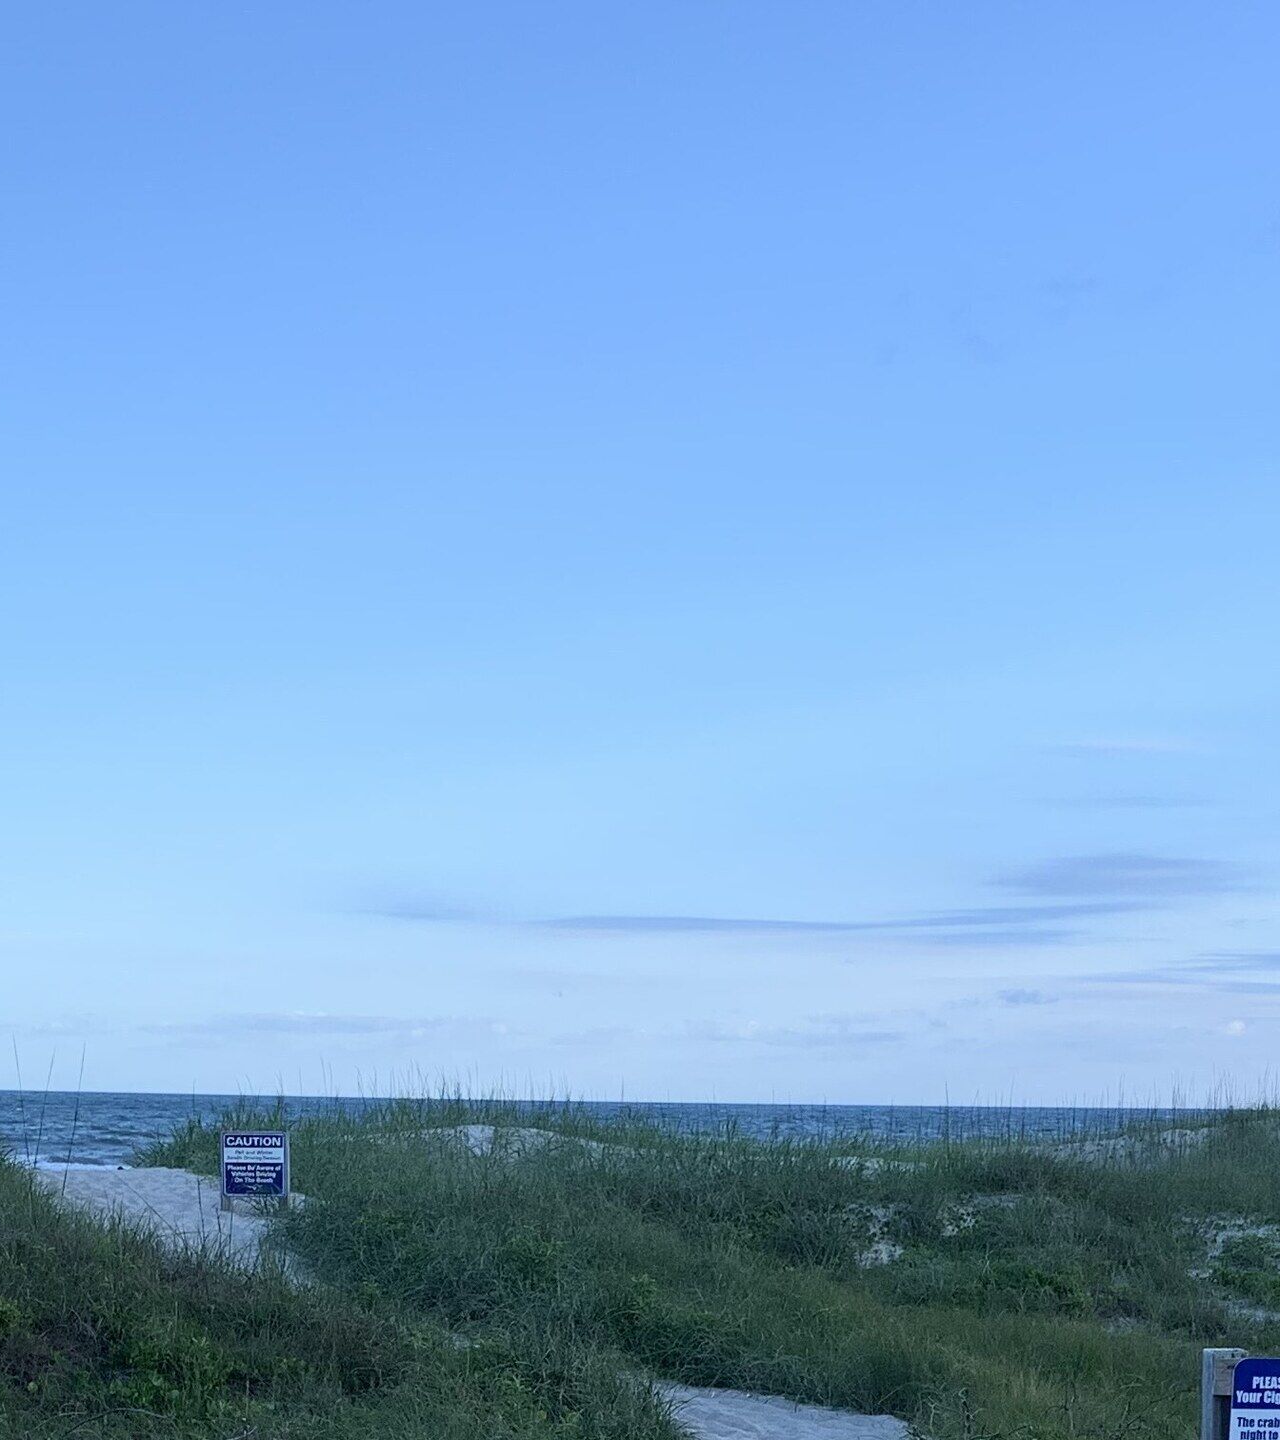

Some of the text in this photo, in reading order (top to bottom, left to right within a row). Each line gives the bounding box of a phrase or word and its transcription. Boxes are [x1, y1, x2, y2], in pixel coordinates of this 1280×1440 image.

[226, 1136, 281, 1146] CAUTION
[1236, 1390, 1262, 1403] Your
[1237, 1417, 1255, 1427] The
[1240, 1430, 1267, 1440] night
[1268, 1431, 1279, 1440] to
